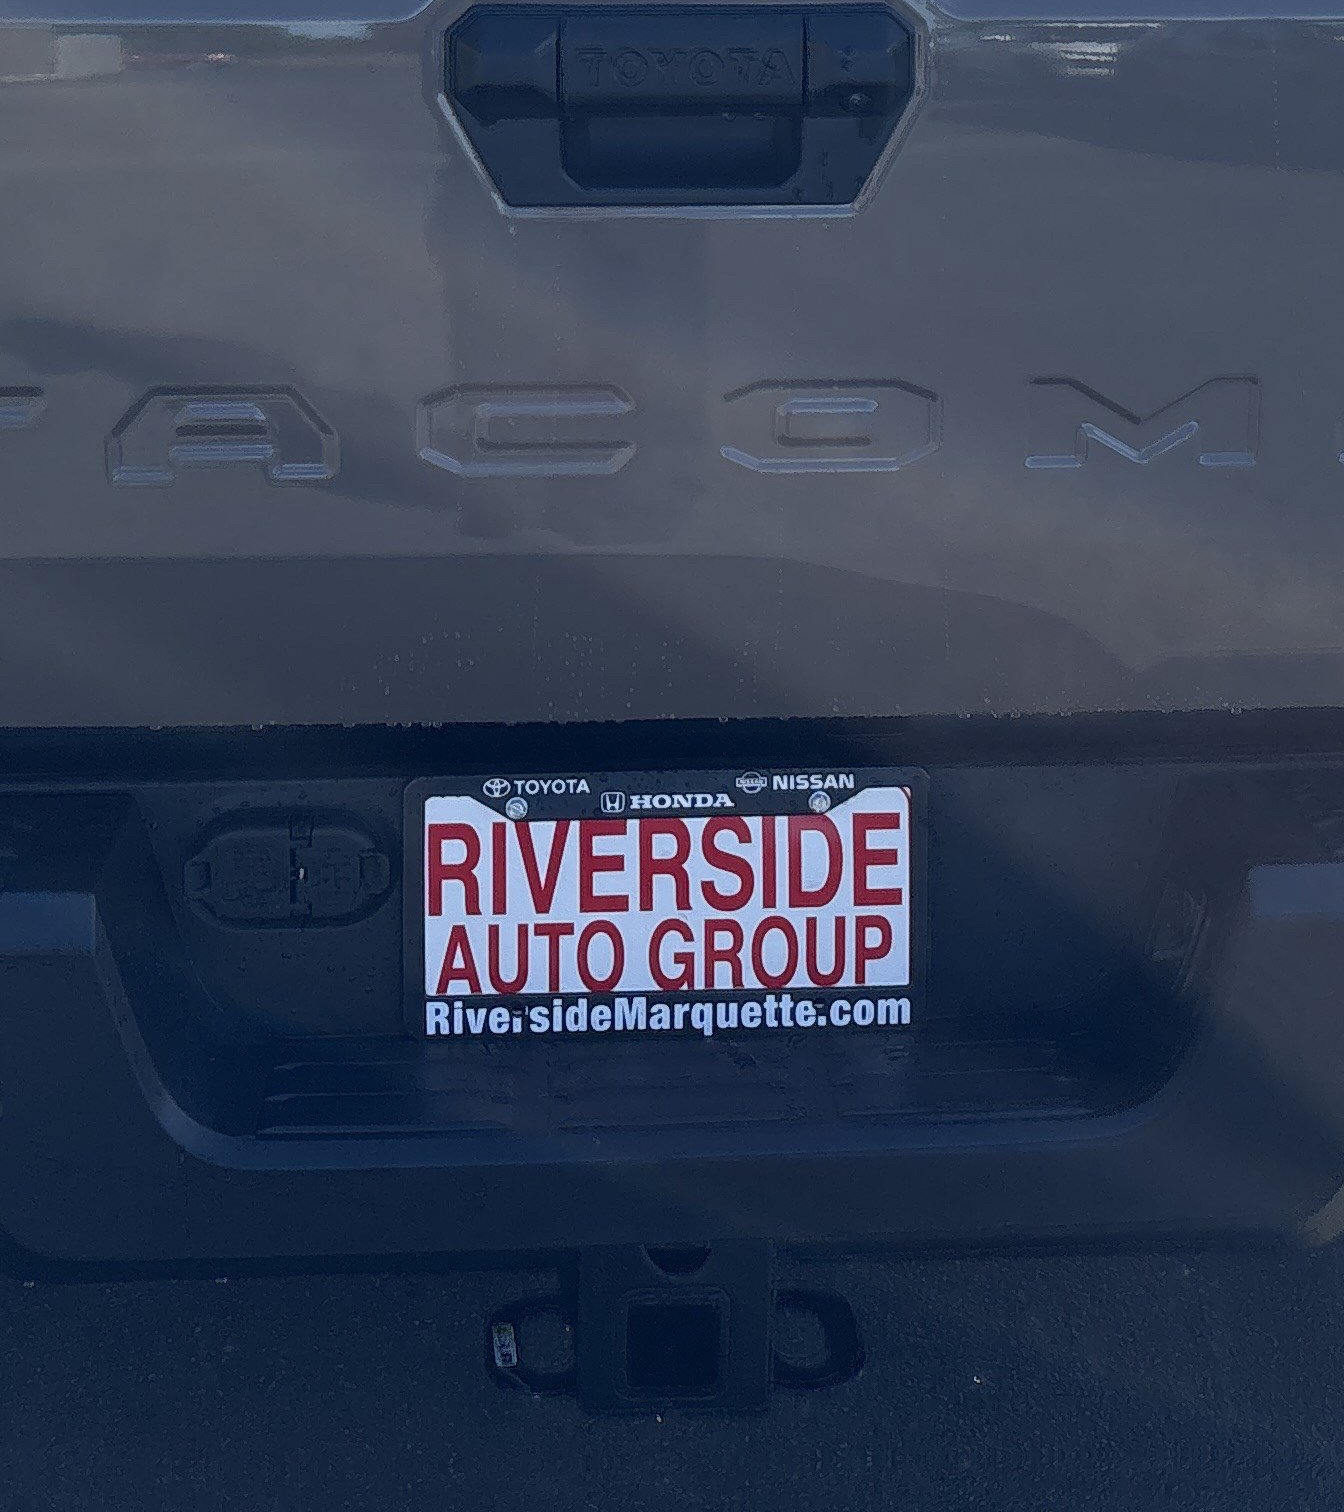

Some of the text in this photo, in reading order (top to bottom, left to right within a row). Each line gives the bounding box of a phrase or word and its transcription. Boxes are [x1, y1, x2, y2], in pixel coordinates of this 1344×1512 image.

[574, 46, 795, 87] TOYOTA
[513, 778, 590, 796] TOYOTA
[772, 773, 855, 791] NISSAN
[630, 792, 735, 810] HONDA
[428, 812, 903, 916] RIVERSIDE
[435, 914, 894, 995] AUTO GROUP
